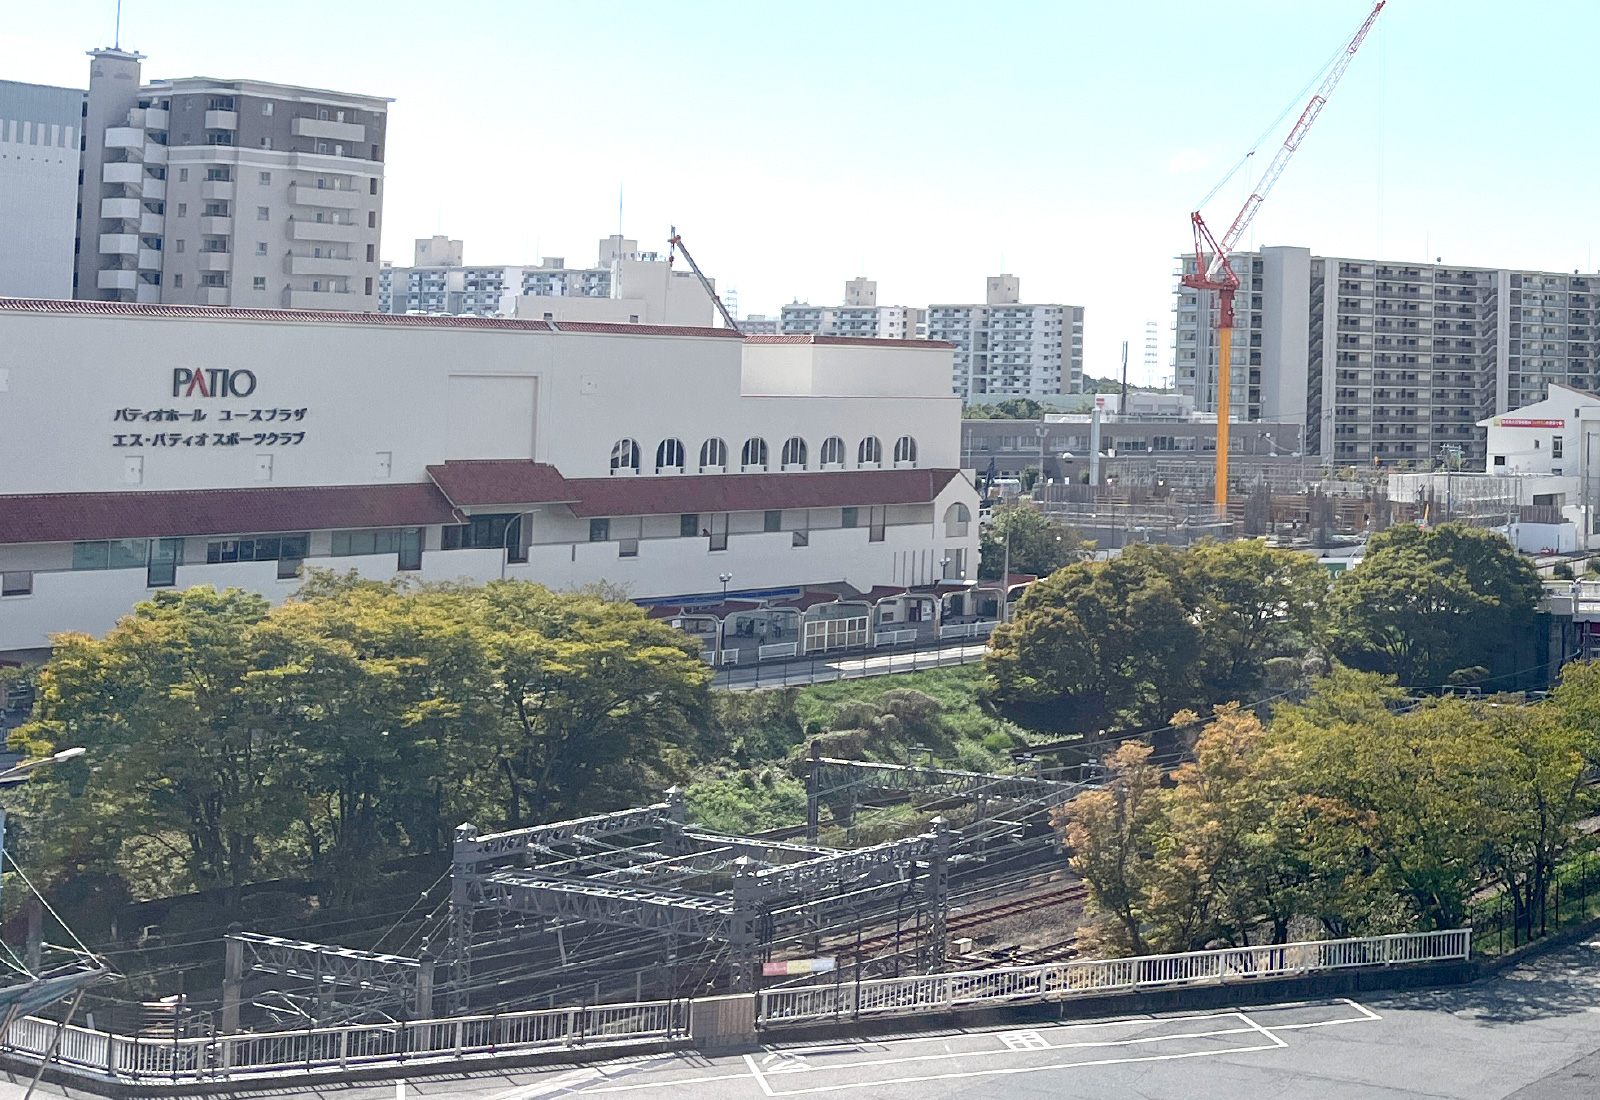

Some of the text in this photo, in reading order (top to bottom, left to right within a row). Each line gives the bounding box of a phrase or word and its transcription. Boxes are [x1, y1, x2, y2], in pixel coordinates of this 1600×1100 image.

[173, 367, 257, 398] PATIO
[113, 408, 308, 422] パティオホール ユースプラザ
[212, 432, 306, 447] スポーツクラブ
